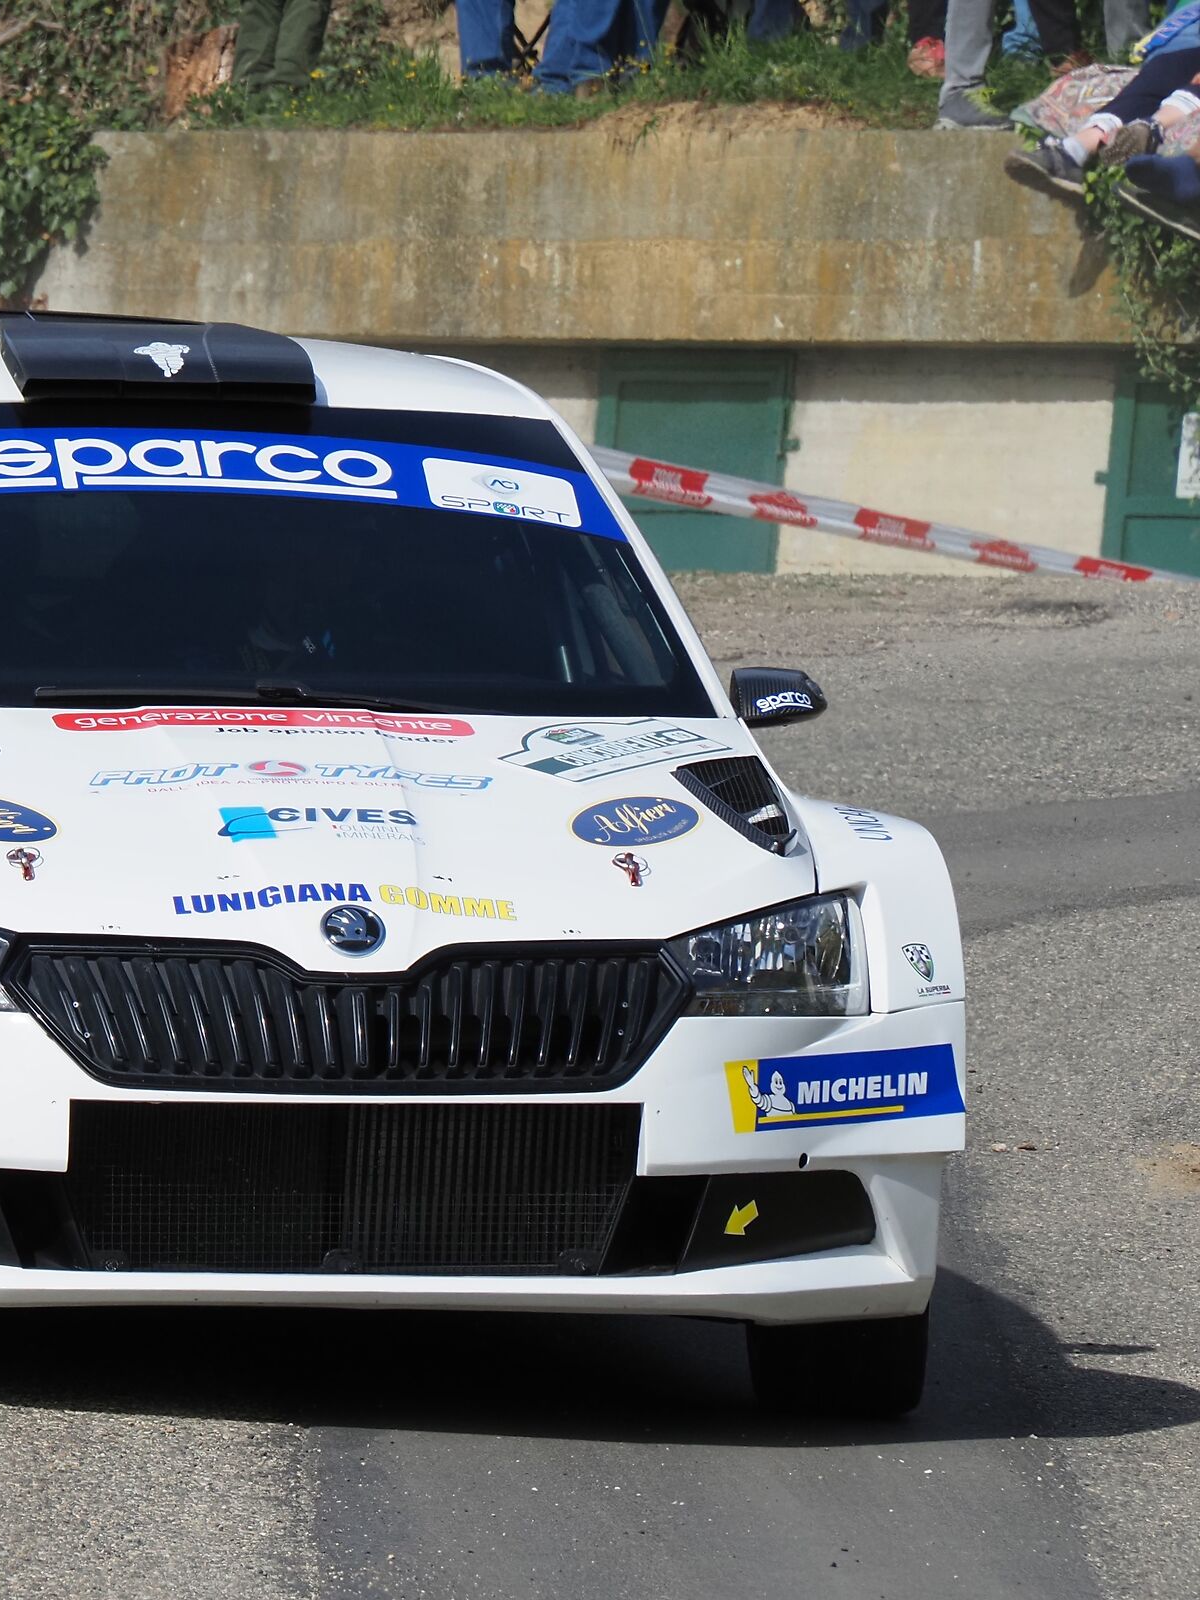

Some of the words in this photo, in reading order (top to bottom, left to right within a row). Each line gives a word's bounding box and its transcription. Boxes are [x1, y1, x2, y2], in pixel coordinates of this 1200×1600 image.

[441, 495, 571, 523] SPORT
[756, 691, 812, 714] sparco
[74, 711, 288, 729] generazione
[302, 712, 453, 731] vincente
[269, 728, 365, 736] opinion
[375, 729, 459, 744] leader
[268, 807, 417, 826] CIVES
[173, 882, 373, 915] LUNIGIANA
[378, 884, 518, 921] GOMME
[797, 1072, 928, 1105] MICHELIN
